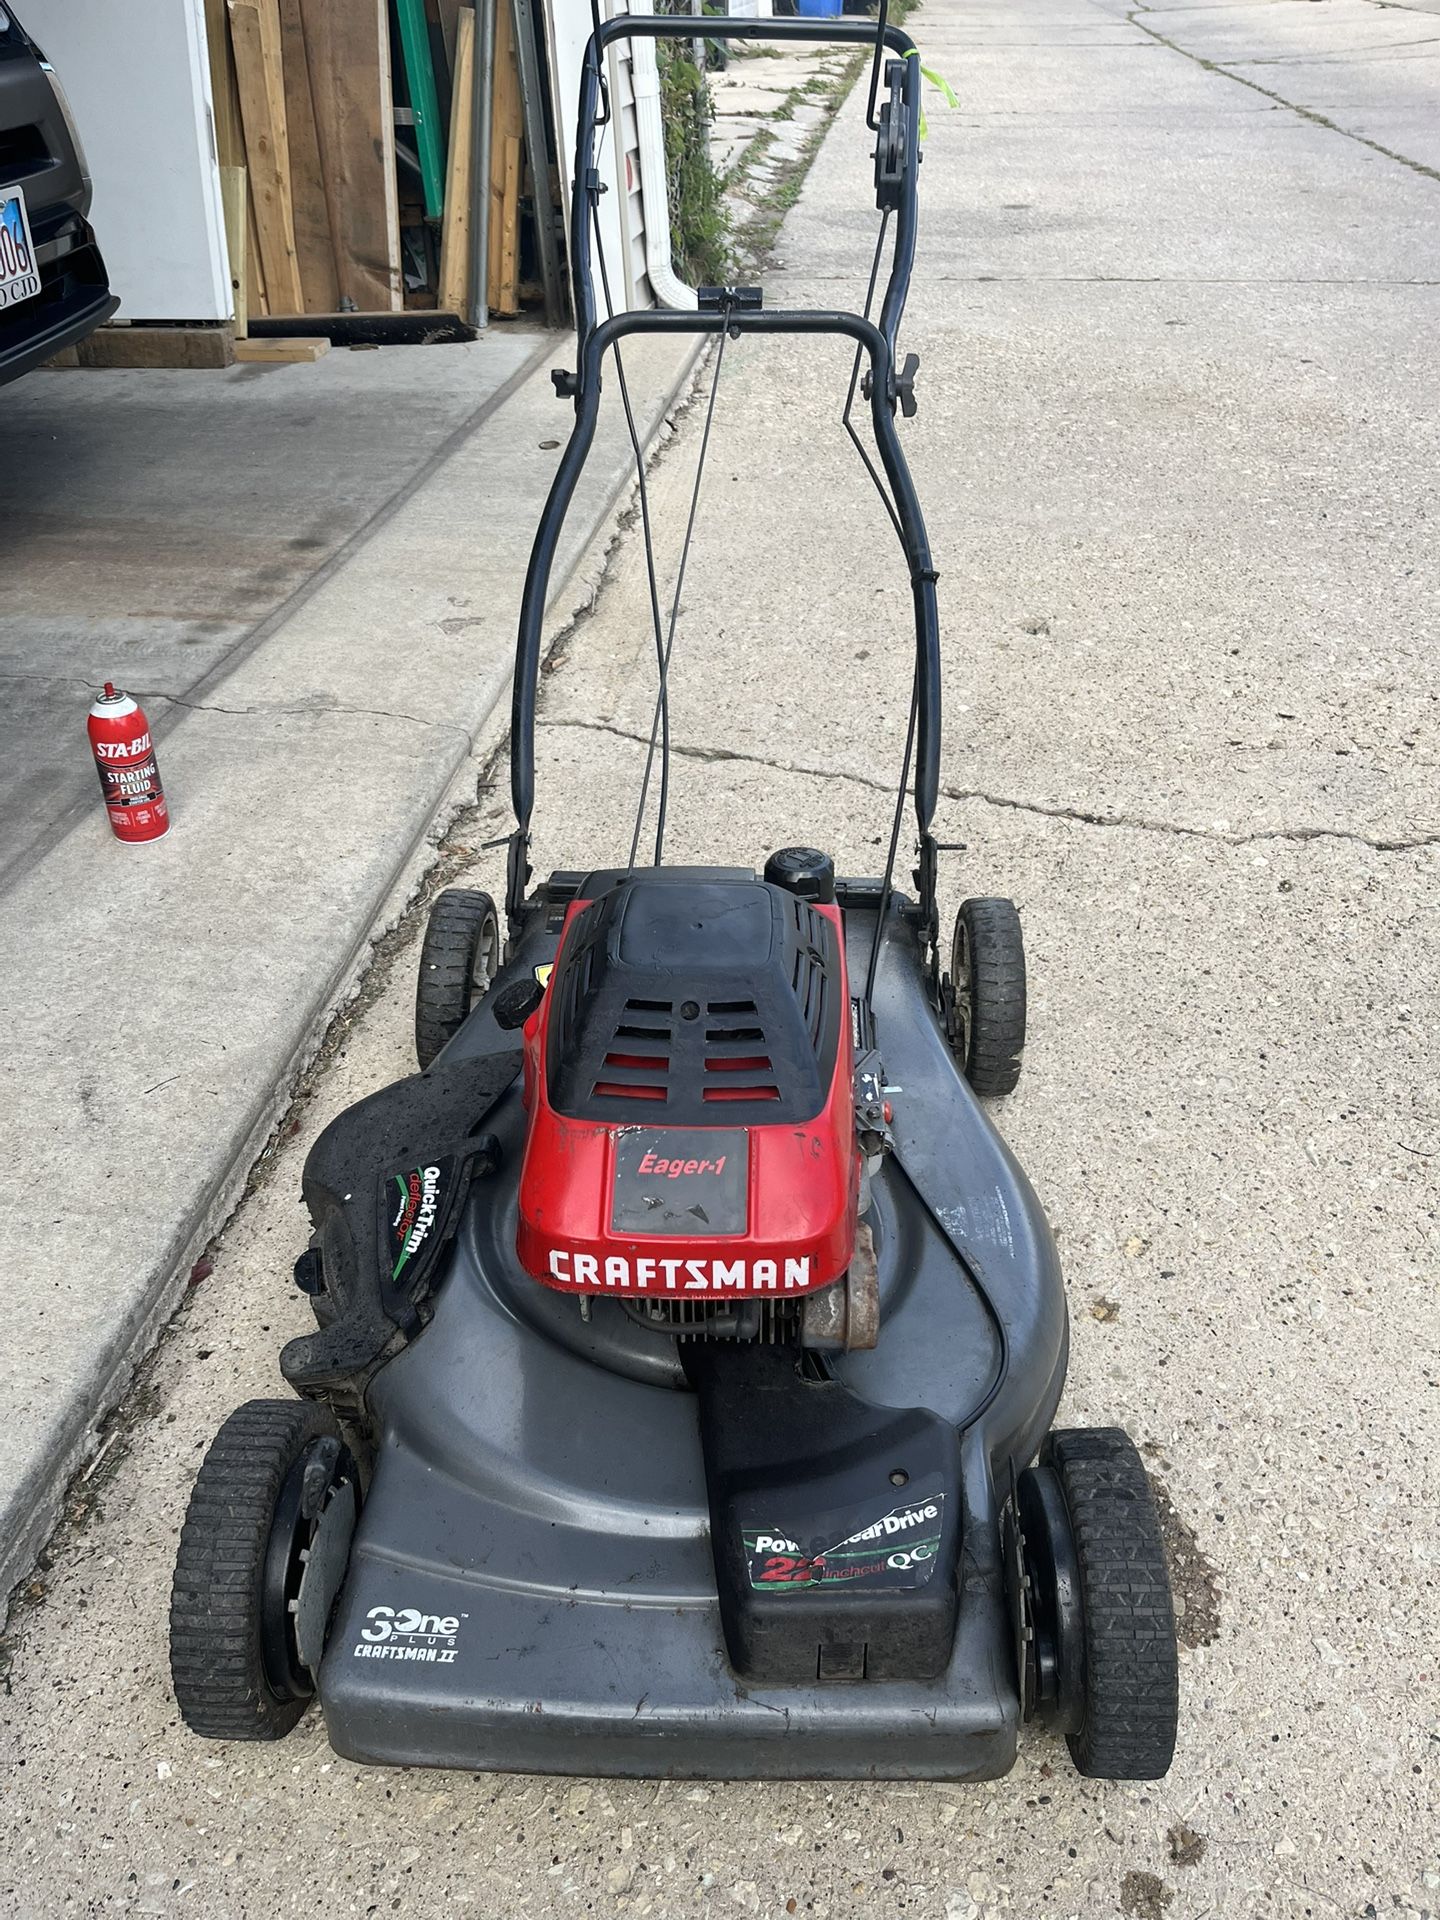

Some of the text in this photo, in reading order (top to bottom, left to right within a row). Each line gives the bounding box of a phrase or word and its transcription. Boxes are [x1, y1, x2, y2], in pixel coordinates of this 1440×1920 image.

[11, 275, 38, 301] CJD
[97, 733, 152, 758] STA-BIL
[107, 763, 155, 783] STARTING
[120, 780, 151, 795] FLUID
[638, 1153, 727, 1179] Eager-1
[395, 1173, 422, 1241] deflector
[405, 1166, 441, 1254] QuickTrim
[548, 1249, 811, 1290] CRAFTSMAN
[886, 1545, 933, 1570] QC
[389, 1634, 456, 1647] PLUS
[353, 1644, 459, 1663] CRAFTSMAN II
